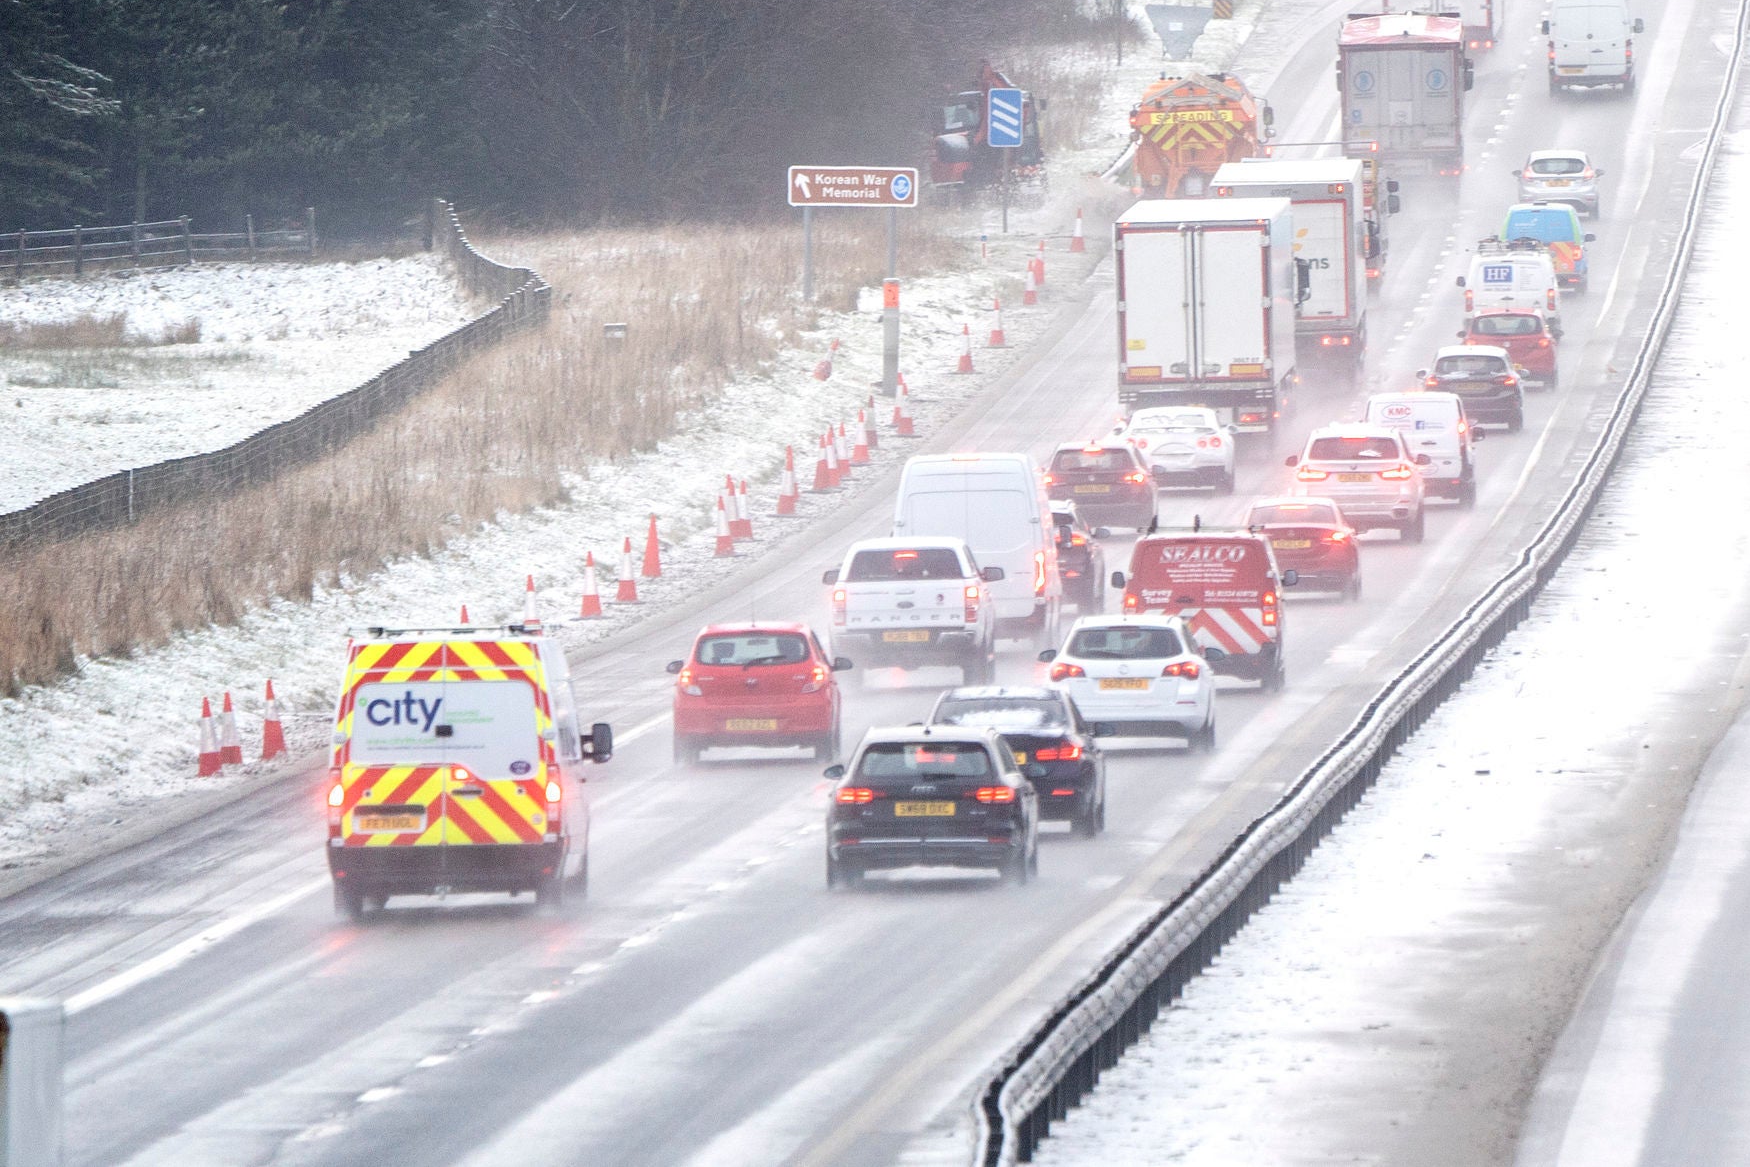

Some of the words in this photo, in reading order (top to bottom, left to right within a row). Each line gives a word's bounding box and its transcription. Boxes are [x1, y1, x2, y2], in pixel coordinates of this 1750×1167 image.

[1156, 112, 1228, 123] SPREADING
[815, 174, 859, 185] Korean
[863, 174, 888, 185] War
[822, 187, 880, 199] Memorial
[1486, 267, 1509, 281] HF
[1387, 407, 1412, 416] KMC
[1160, 544, 1246, 564] SEALCO
[1141, 589, 1173, 598] Survey
[851, 614, 961, 623] RANGER
[366, 690, 444, 733] city
